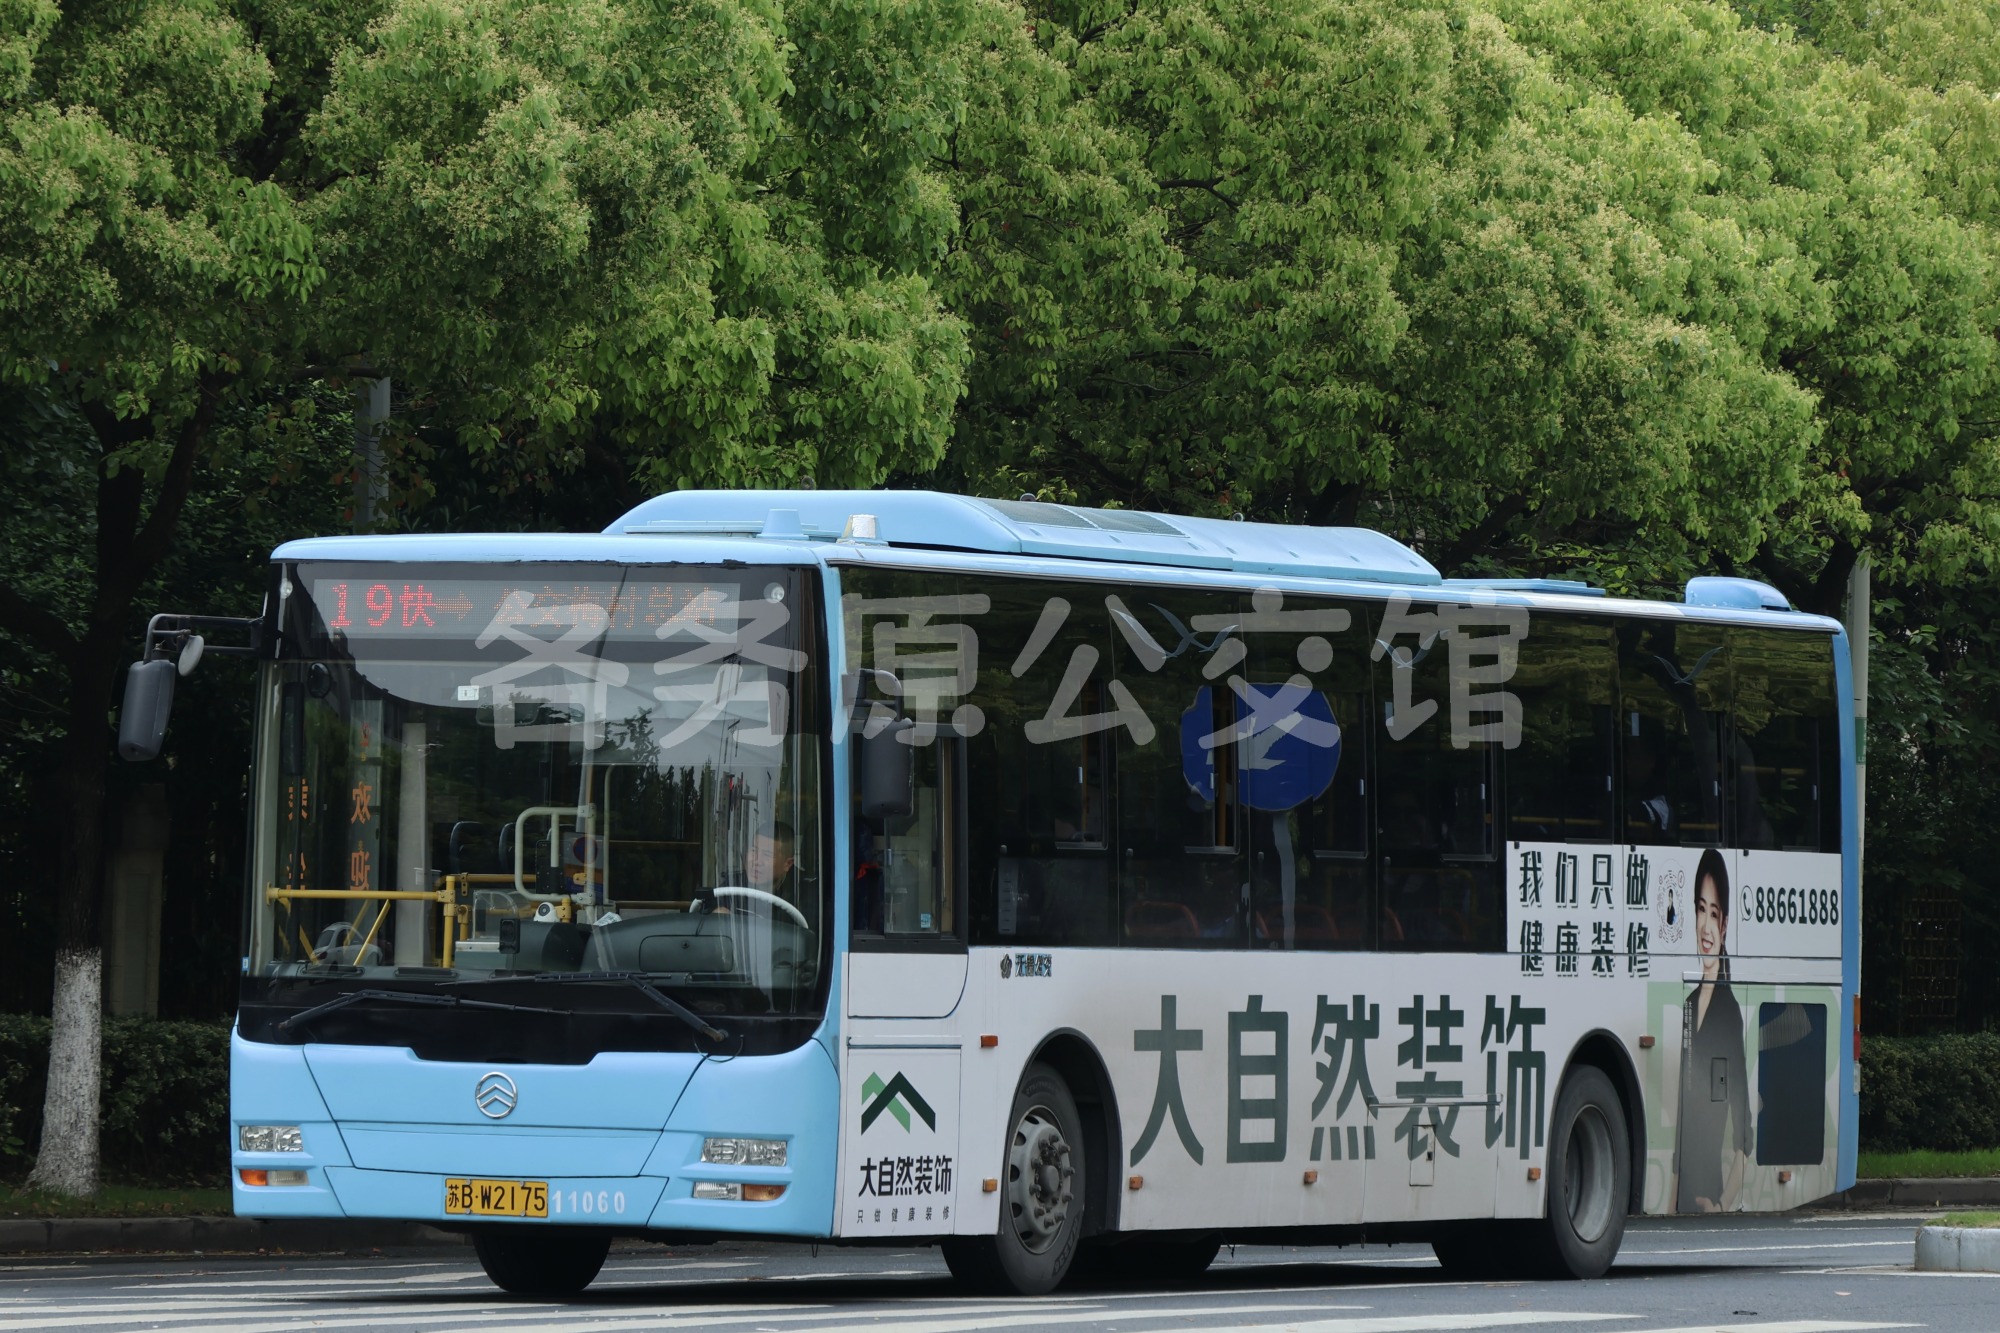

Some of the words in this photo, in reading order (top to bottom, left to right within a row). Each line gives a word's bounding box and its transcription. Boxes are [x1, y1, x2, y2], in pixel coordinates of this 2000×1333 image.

[330, 584, 437, 627] 19快
[1519, 851, 1650, 910] 我们只做
[1756, 886, 1839, 926] 88661888
[1520, 920, 1650, 977] 健康装修
[1130, 995, 1546, 1167] 大自然装饰
[858, 1155, 953, 1197] 大自然装饰
[552, 1190, 625, 1214] 11060
[857, 1206, 950, 1225] 只做健康装修
